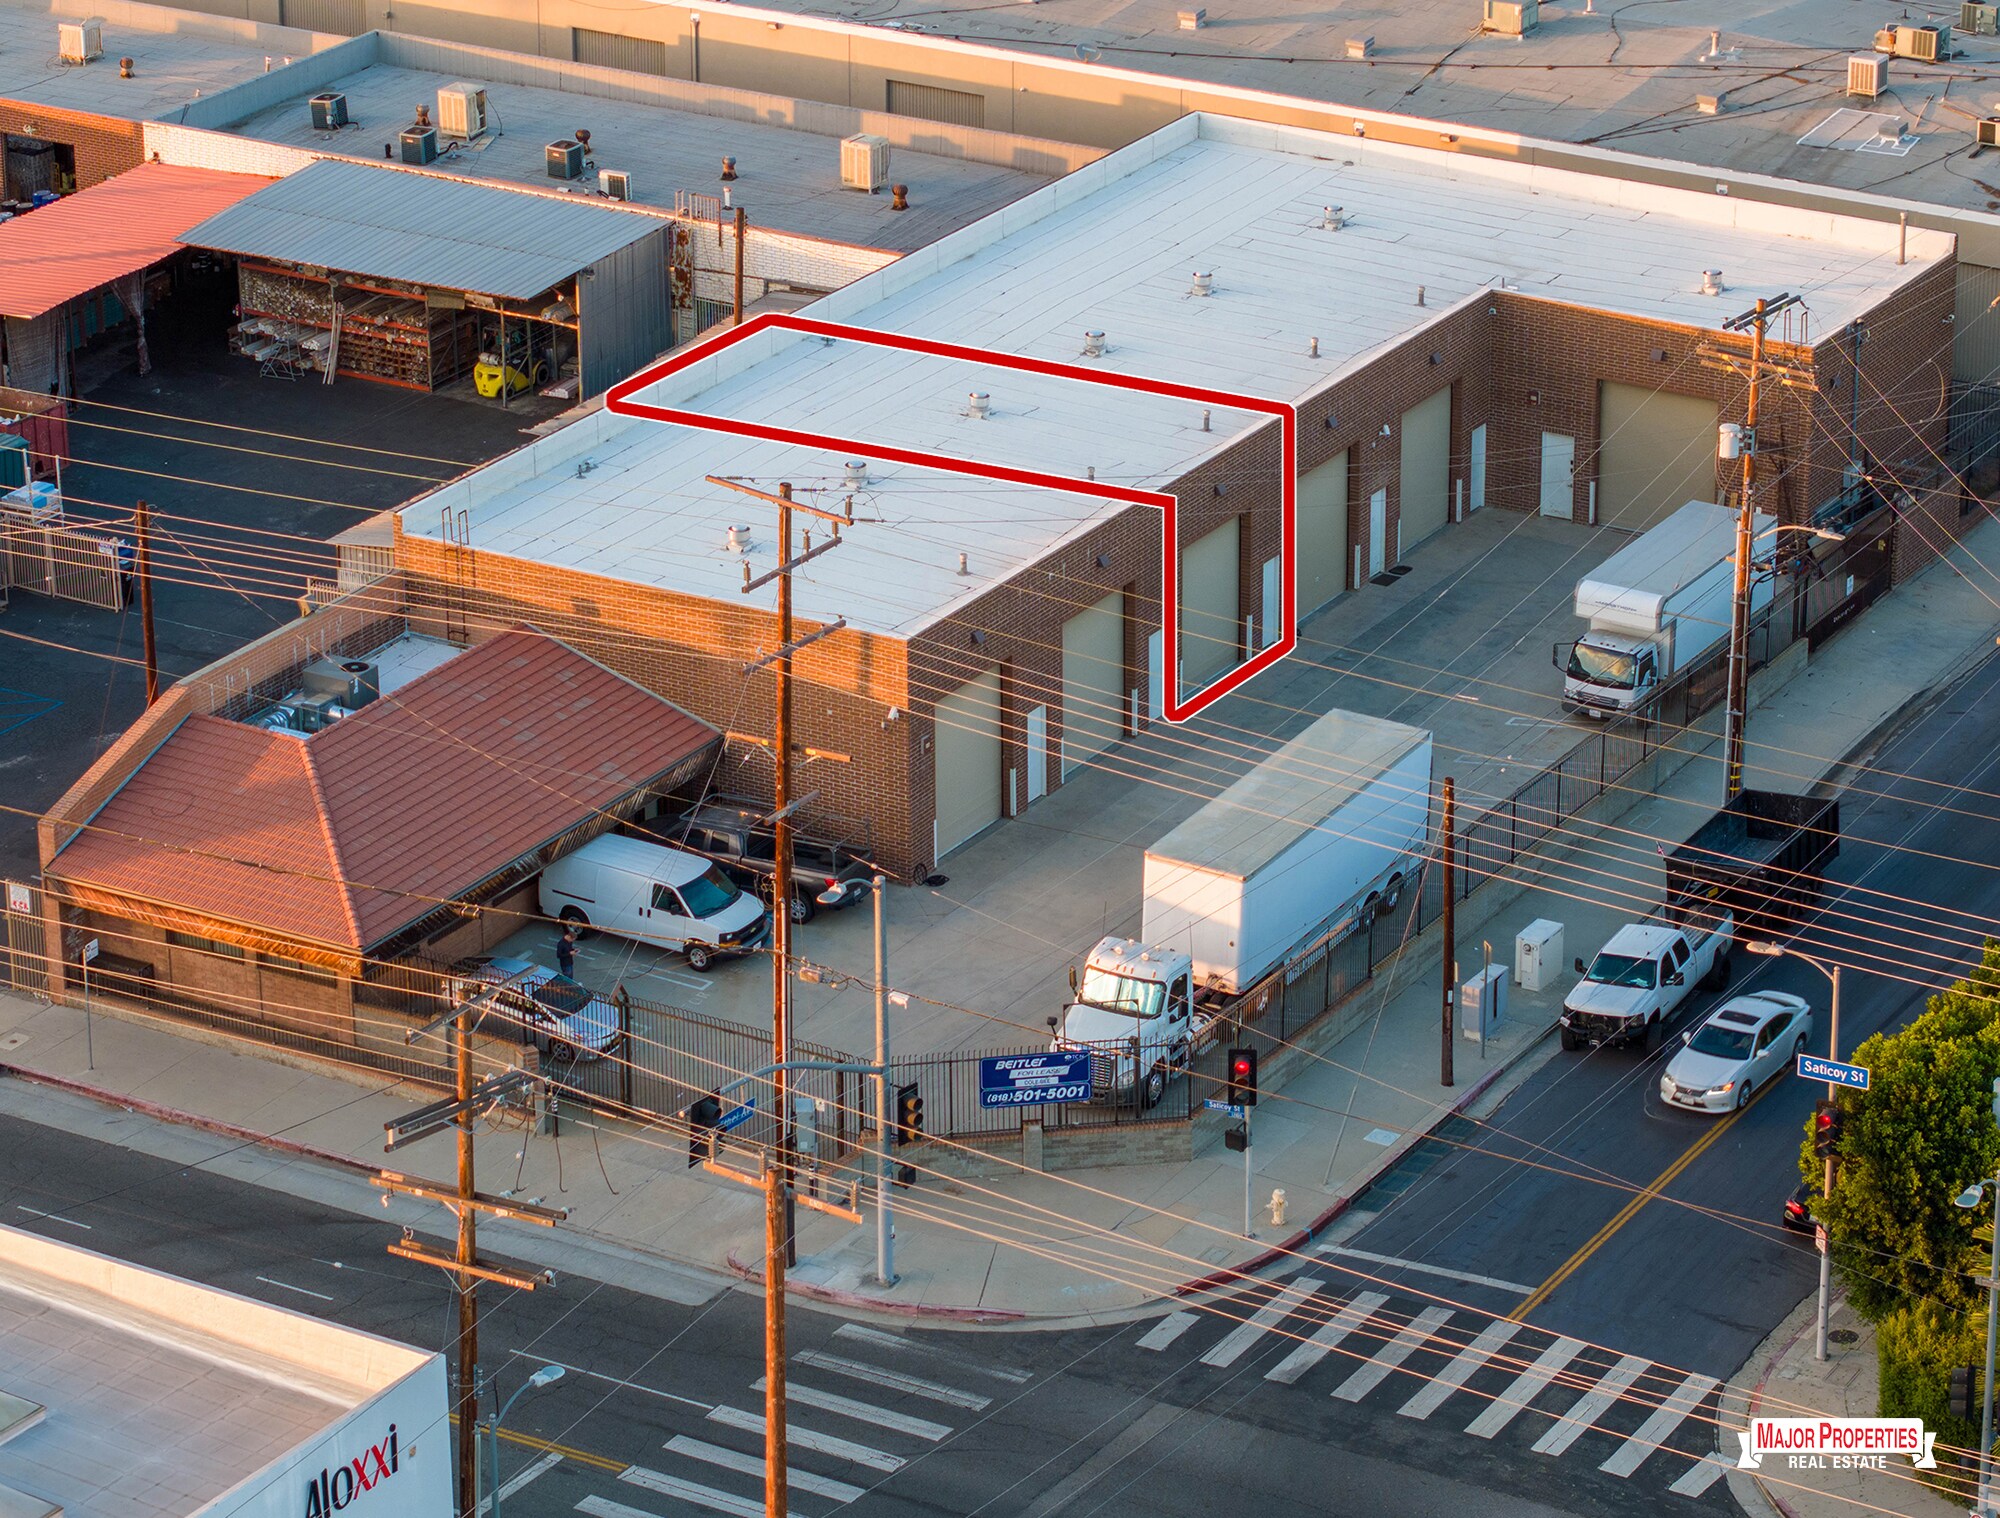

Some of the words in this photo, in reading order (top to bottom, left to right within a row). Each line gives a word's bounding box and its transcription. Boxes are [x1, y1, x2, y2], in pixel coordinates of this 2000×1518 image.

[1035, 1067, 1060, 1075] LEASE
[1804, 1061, 1847, 1081] Saticoy
[1850, 1070, 1864, 1083] St
[1209, 1102, 1231, 1111] Saticoy
[305, 1423, 399, 1518] Aloxxi
